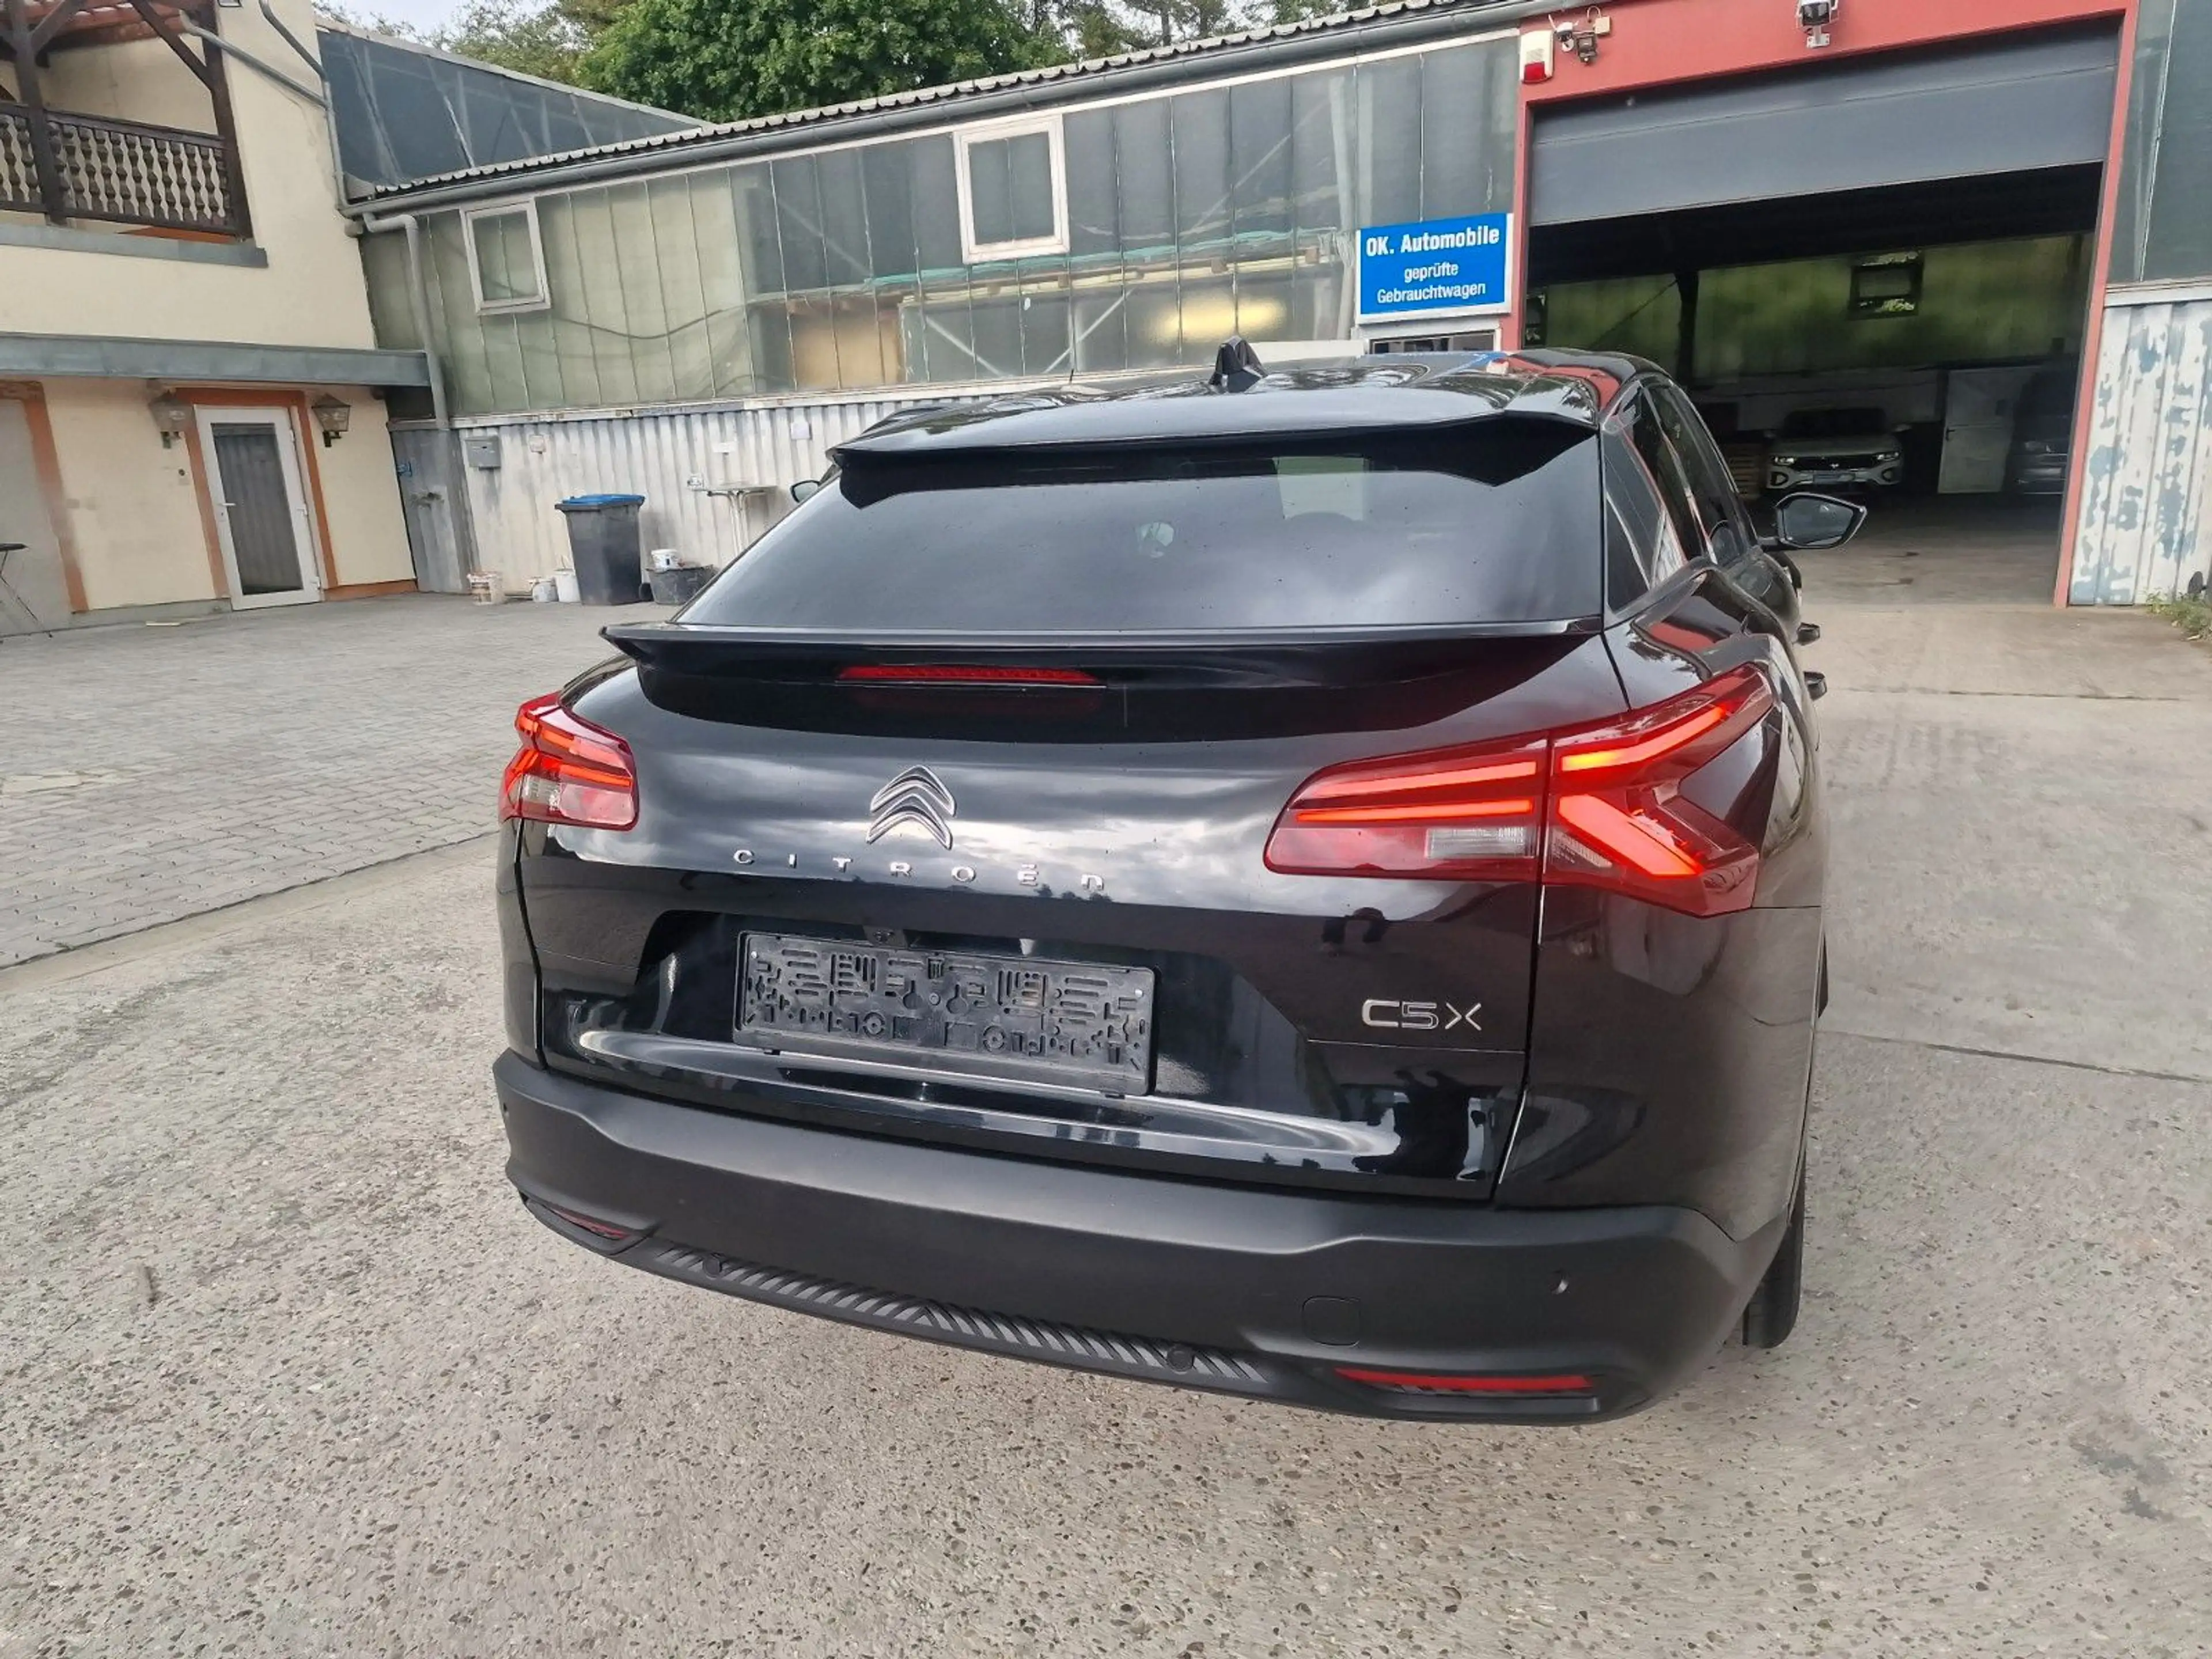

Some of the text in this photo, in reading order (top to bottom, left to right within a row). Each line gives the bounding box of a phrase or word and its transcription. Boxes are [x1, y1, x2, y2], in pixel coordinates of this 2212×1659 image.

[1366, 225, 1500, 256] OK. Automobile
[1404, 262, 1459, 282] geprüfte
[1377, 282, 1486, 304] Gebrauchtwagen
[733, 849, 1105, 891] CITROËN
